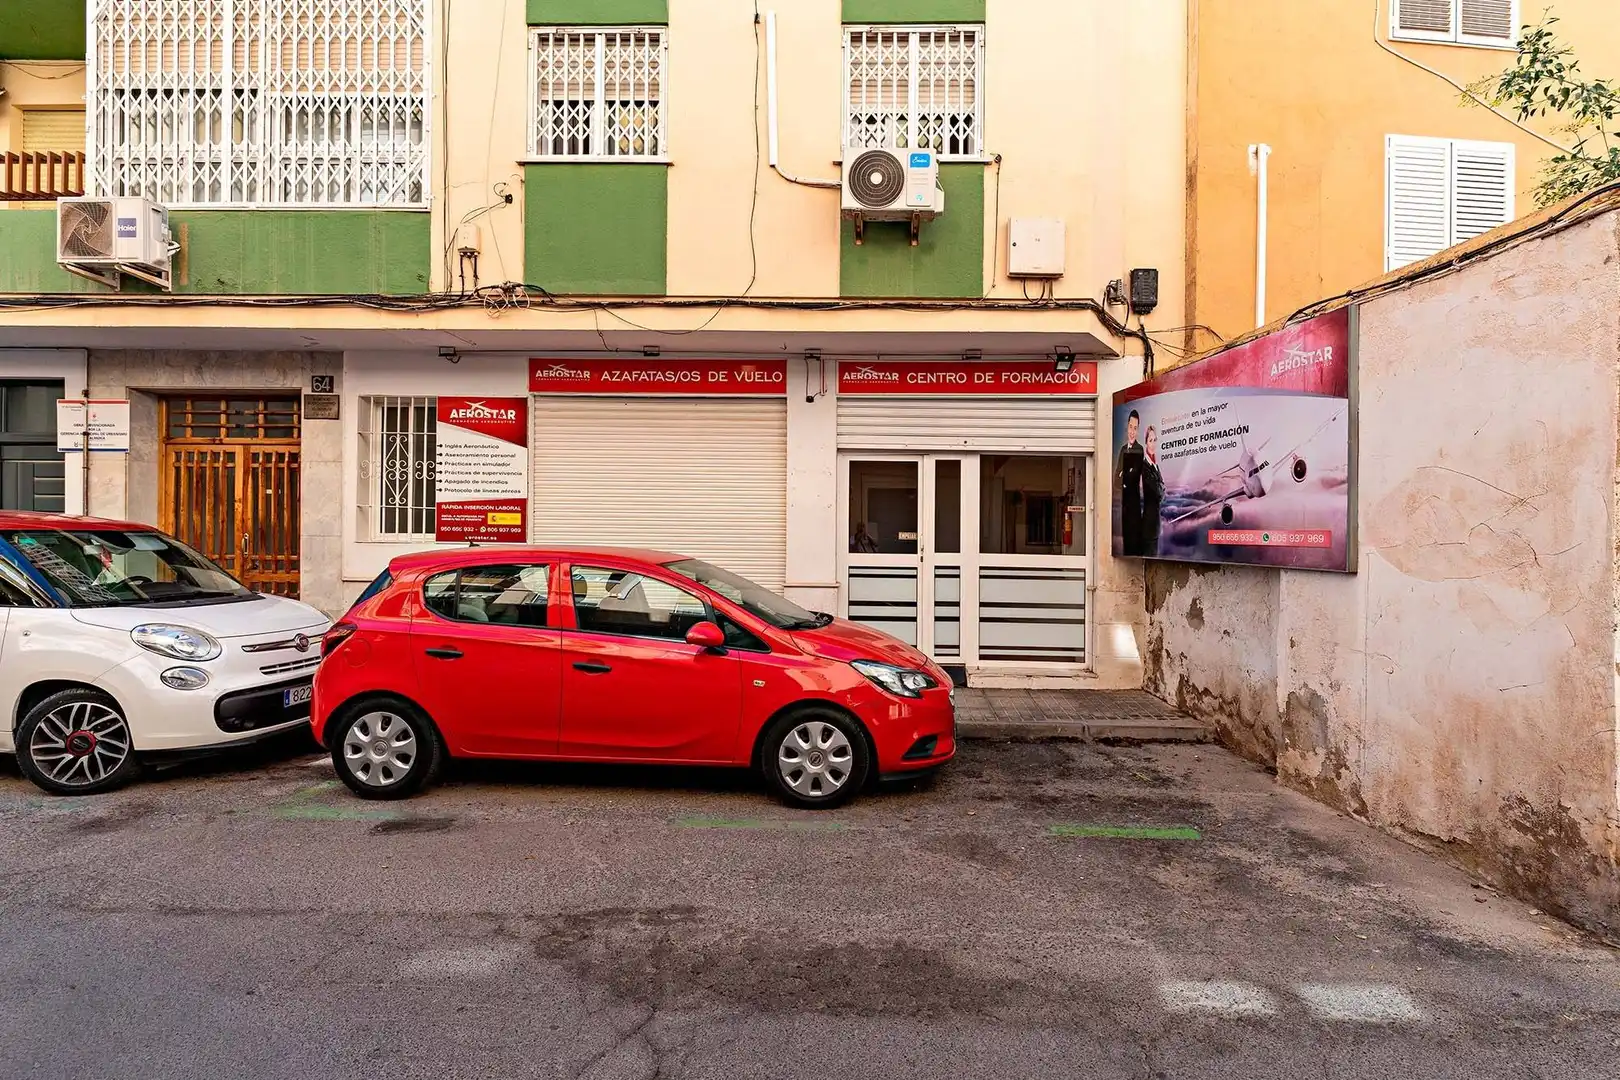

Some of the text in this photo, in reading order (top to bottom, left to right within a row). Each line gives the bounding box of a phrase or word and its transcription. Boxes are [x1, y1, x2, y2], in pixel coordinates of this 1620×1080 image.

[1270, 346, 1332, 376] AEROSTAR
[601, 371, 782, 383] AZAFATAS/OS DE VUELO
[843, 372, 899, 380] AEROSTAR
[907, 369, 1090, 384] CENTRO DE FORMACIÓN
[313, 377, 330, 391] 64
[450, 409, 516, 420] AEROSTAR
[1207, 402, 1228, 413] mayor
[1161, 424, 1184, 436] aventura
[1202, 417, 1216, 425] vida
[1161, 425, 1249, 450] CENTRO DE FORMACIÓN
[1161, 452, 1173, 461] para
[1174, 446, 1207, 459] azafatas/os
[1218, 440, 1237, 450] vuelo
[1289, 534, 1304, 542] 937
[1307, 534, 1324, 543] 969
[293, 686, 311, 702] 822
